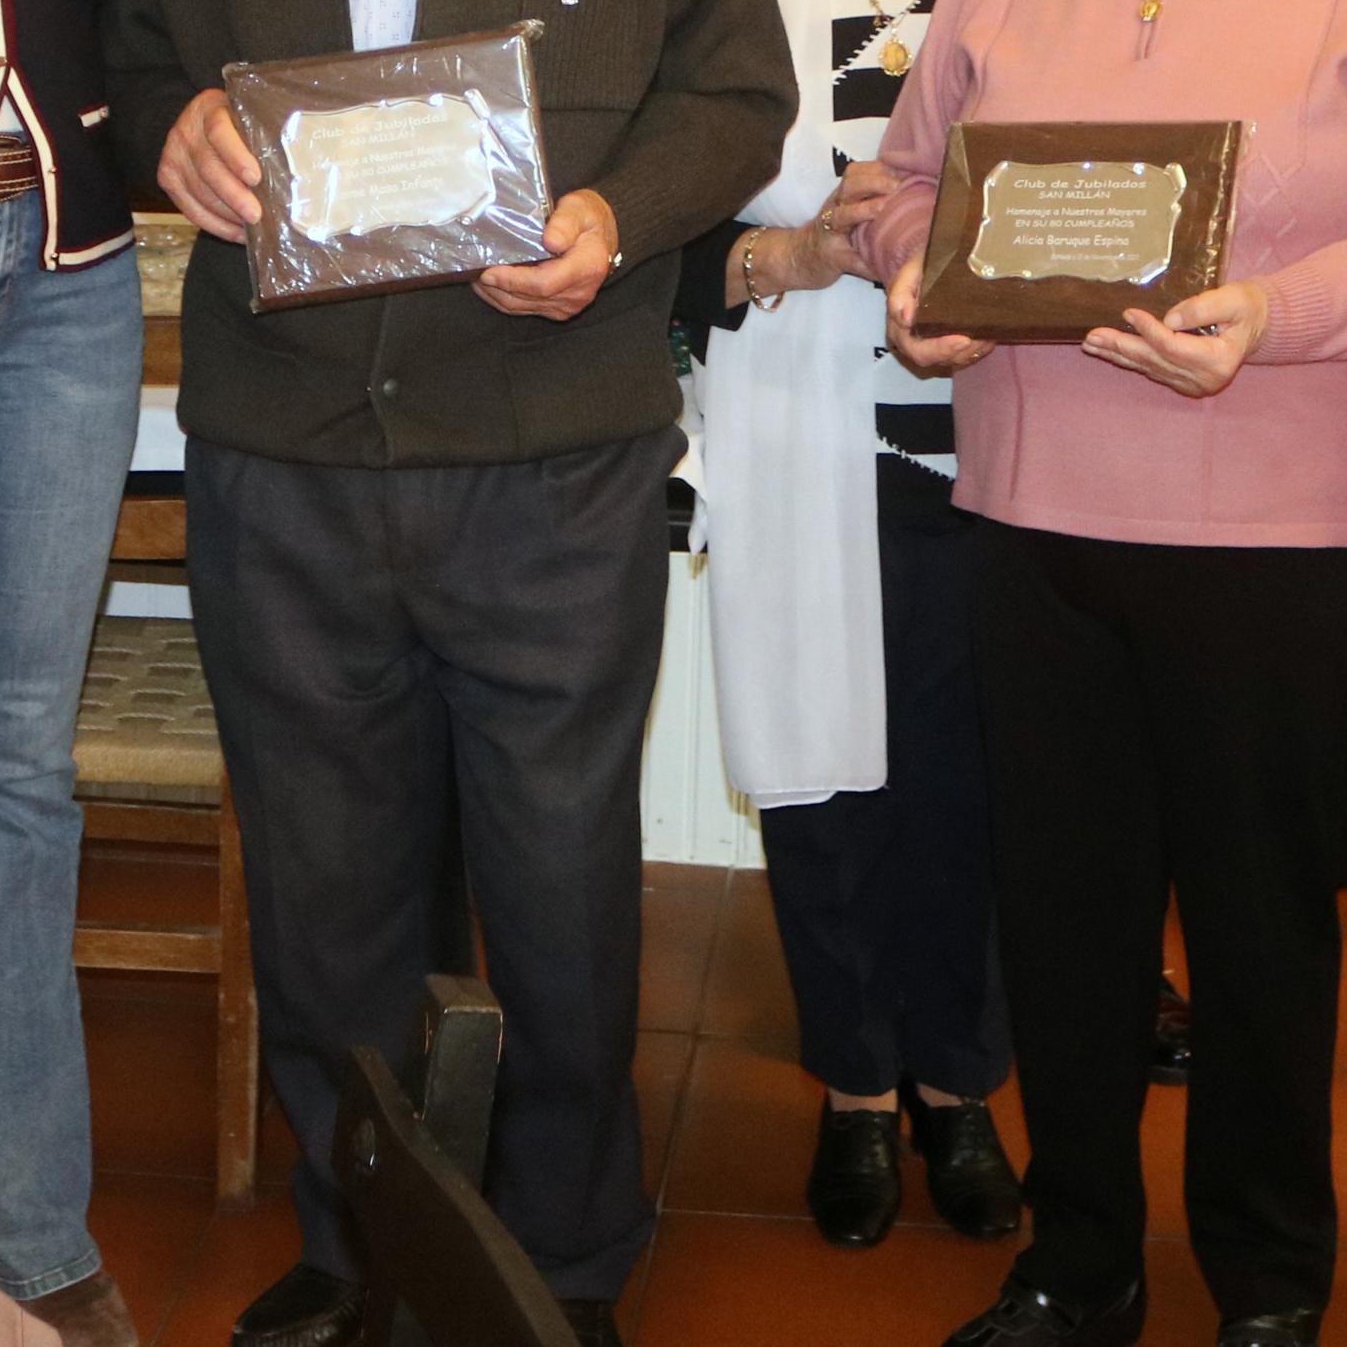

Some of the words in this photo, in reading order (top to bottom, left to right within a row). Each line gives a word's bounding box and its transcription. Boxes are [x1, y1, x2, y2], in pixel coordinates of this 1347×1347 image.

[311, 127, 344, 140] Club
[374, 114, 449, 132] Jubilados
[1013, 179, 1046, 189] Club
[1050, 179, 1069, 189] de
[1073, 179, 1148, 189] Jubilados
[1038, 191, 1063, 200] SAN
[1064, 189, 1111, 200] MILLÁN
[1005, 207, 1051, 218] Homenaje
[1060, 207, 1104, 216] Nuestros
[1106, 207, 1148, 218] Mayores
[1014, 219, 1030, 228] EN
[1032, 219, 1047, 228] SU
[1064, 217, 1135, 228] CUMPLEAÑOS
[1013, 235, 1044, 245] Alicia
[1046, 234, 1091, 248] Baruque
